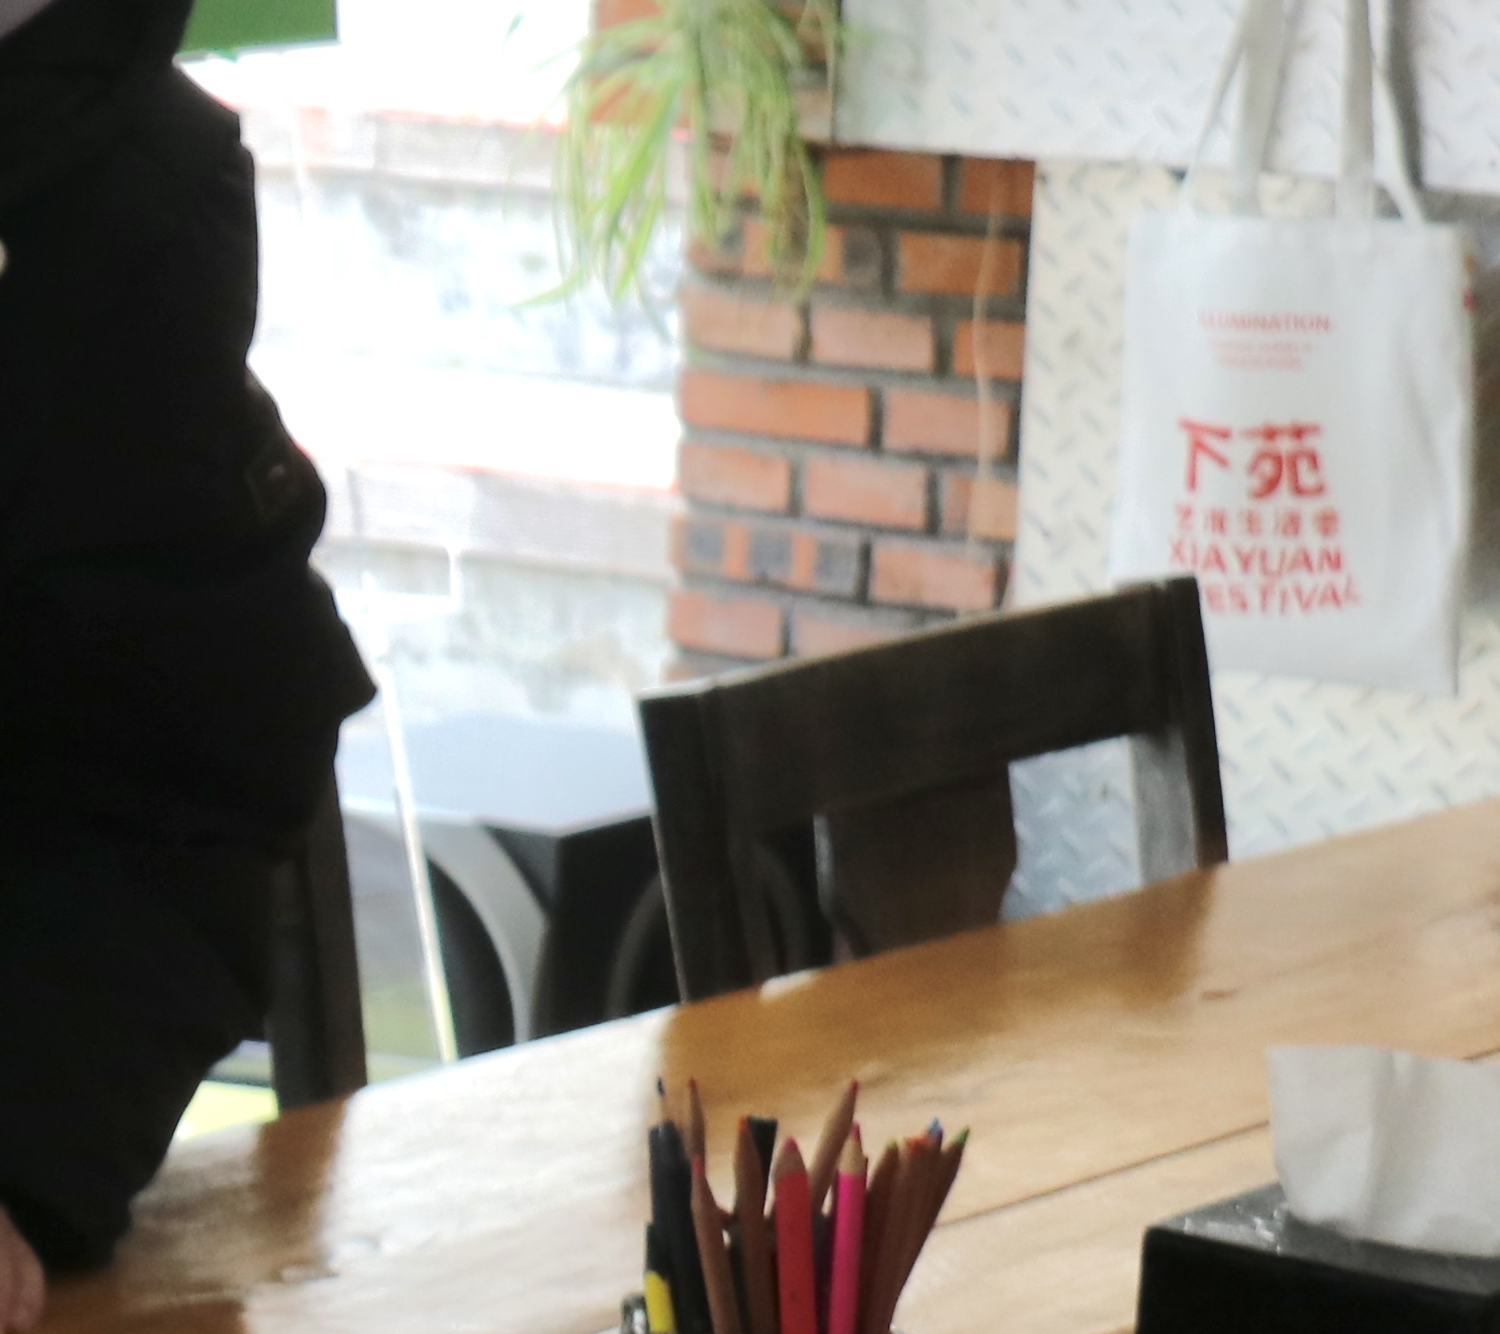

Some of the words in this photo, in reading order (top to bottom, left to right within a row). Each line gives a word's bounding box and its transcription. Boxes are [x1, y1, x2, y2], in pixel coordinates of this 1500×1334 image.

[1177, 419, 1325, 499] 下苑
[1170, 537, 1342, 578] XIAYUAN
[1203, 573, 1361, 616] ESTIVAL
